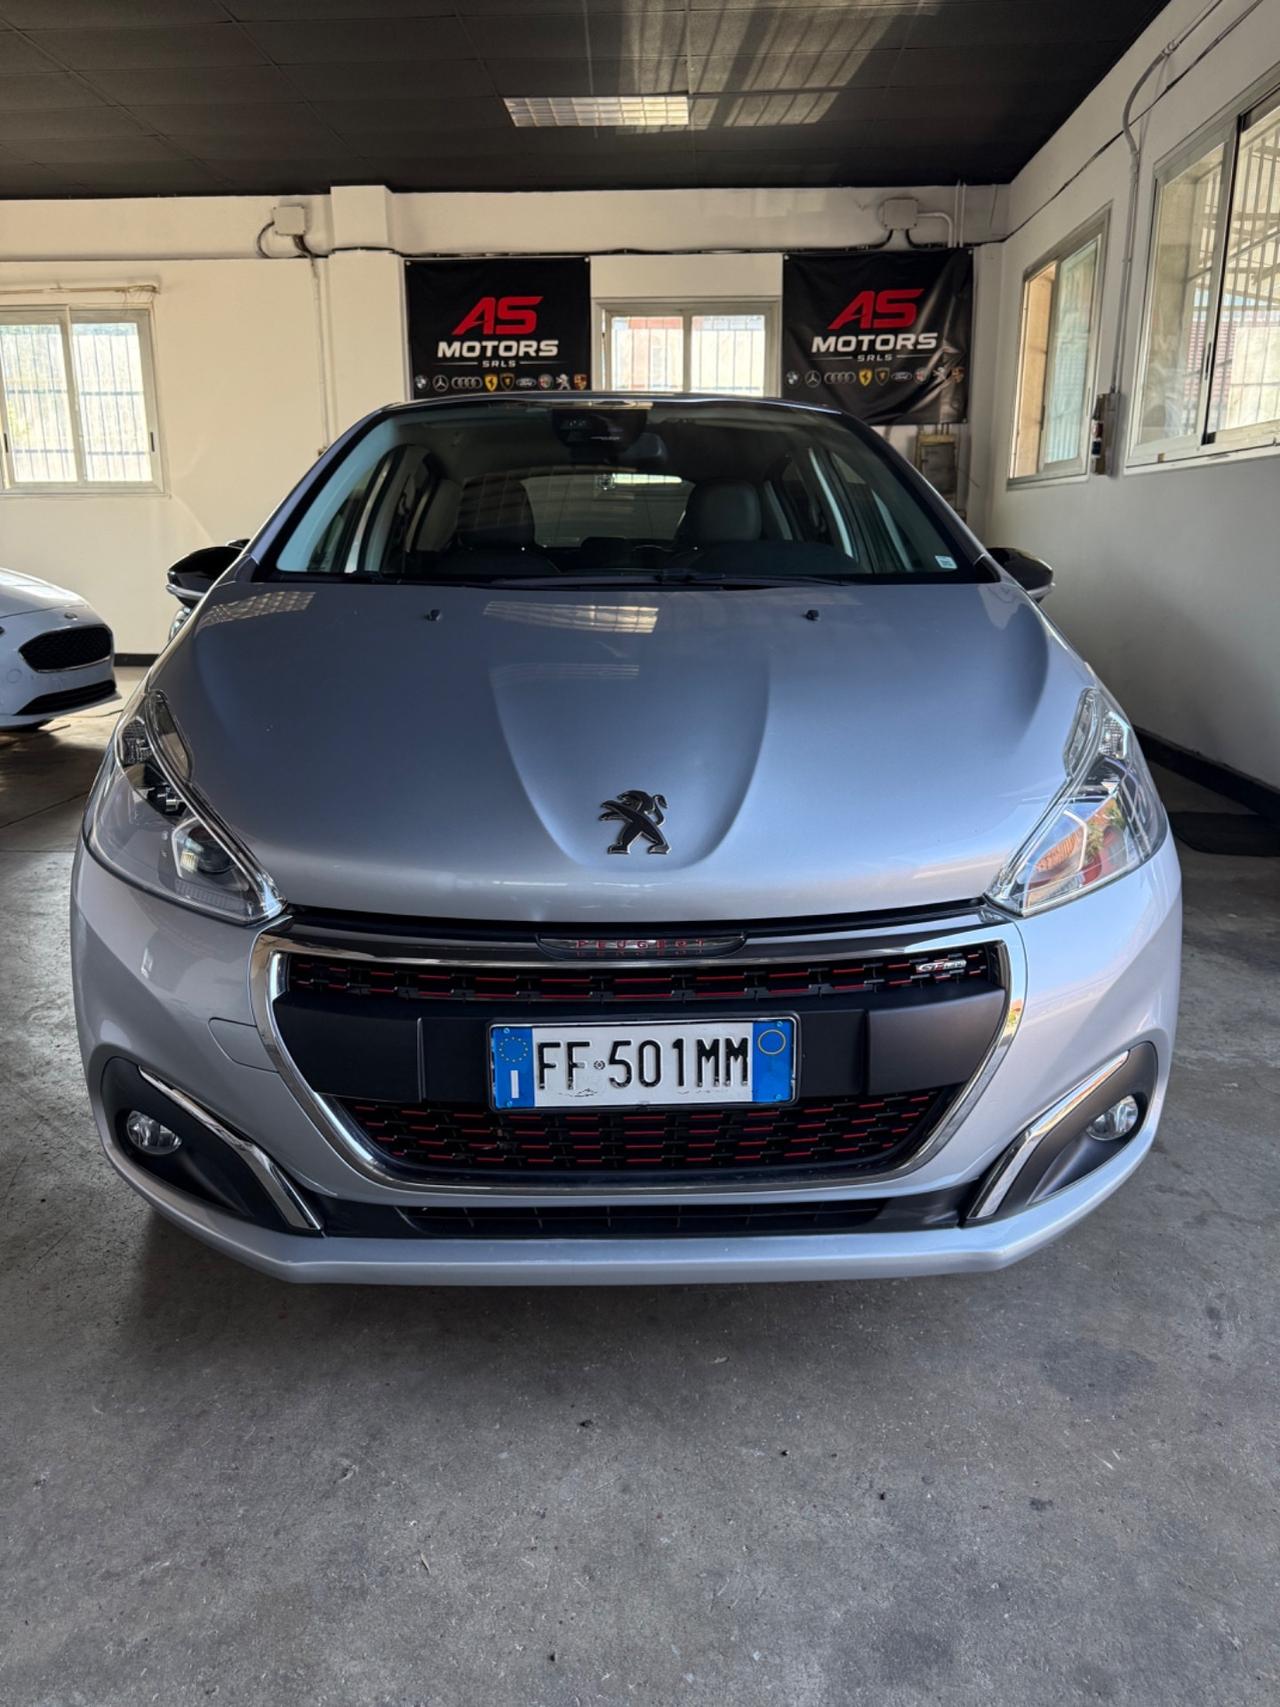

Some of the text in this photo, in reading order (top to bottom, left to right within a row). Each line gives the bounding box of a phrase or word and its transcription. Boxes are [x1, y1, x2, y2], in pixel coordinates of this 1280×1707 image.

[452, 296, 543, 335] AS
[828, 289, 923, 330] AS
[437, 340, 558, 358] MOTORS
[812, 333, 938, 353] MOTORS
[857, 354, 893, 362] SRLS
